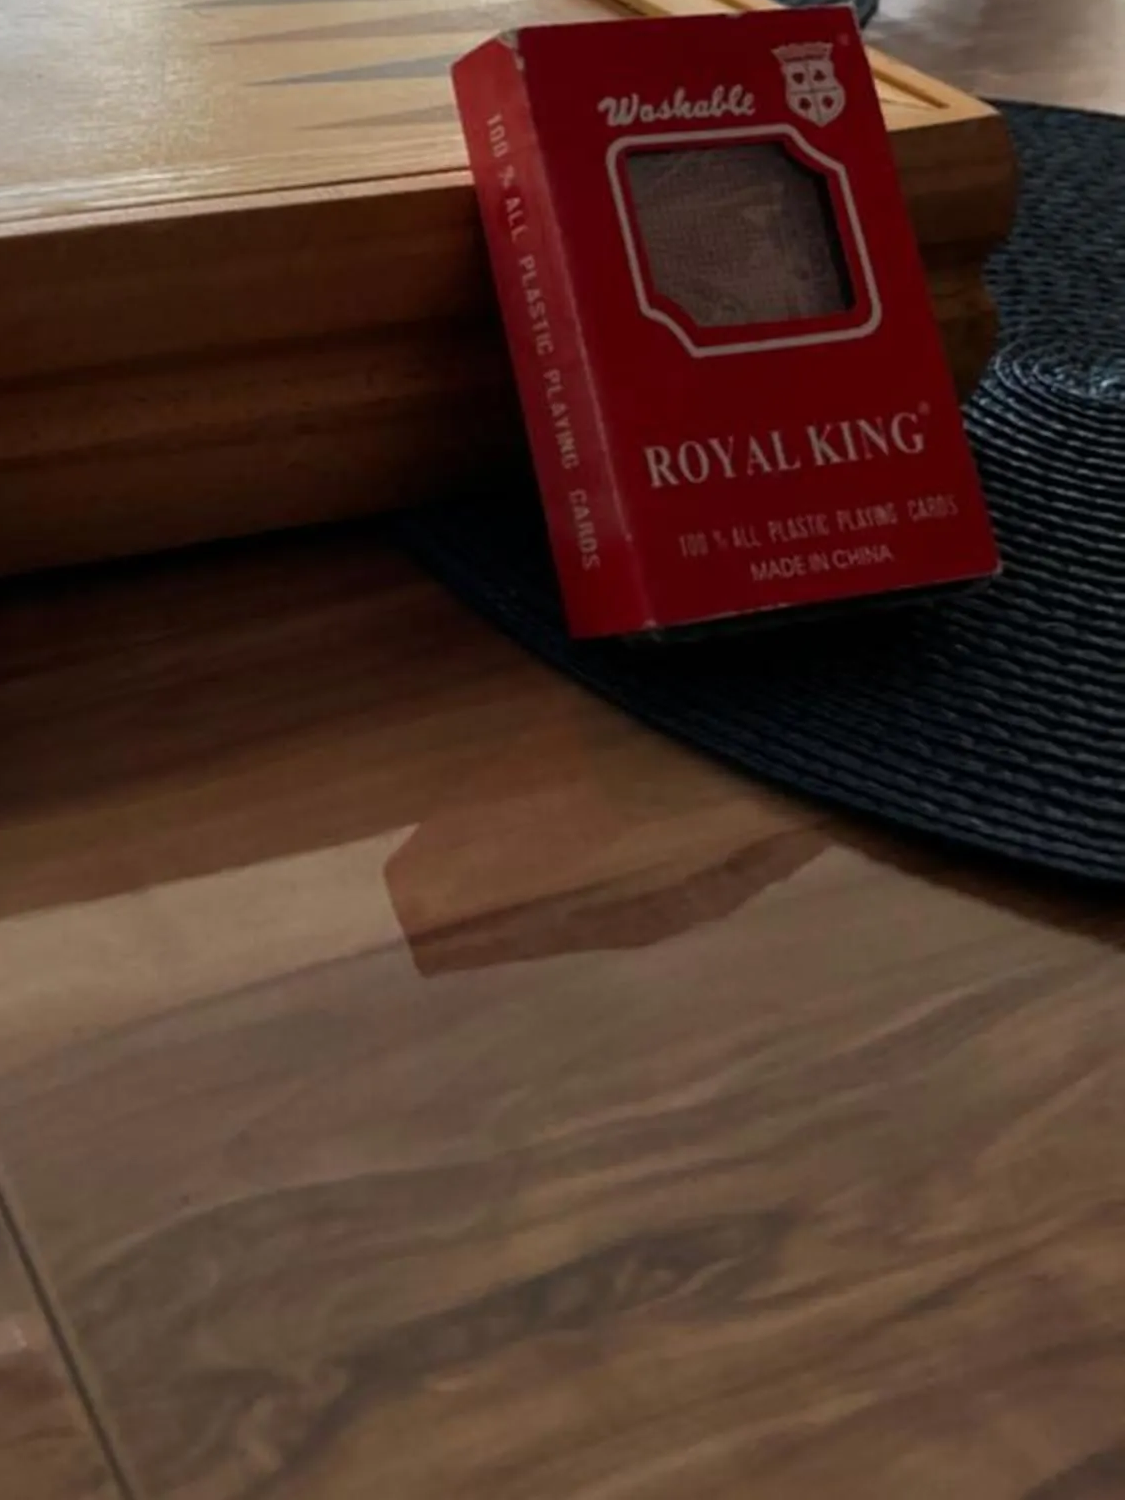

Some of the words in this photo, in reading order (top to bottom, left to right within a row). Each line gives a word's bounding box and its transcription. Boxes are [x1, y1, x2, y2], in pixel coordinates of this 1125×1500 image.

[598, 83, 757, 126] Washable
[485, 112, 510, 158] 100
[505, 195, 528, 245] ALL
[518, 254, 555, 357] PLASTIC
[543, 366, 580, 472] PLAYING
[567, 487, 602, 572] CARDS
[643, 429, 802, 490] ROYAL
[731, 525, 763, 549] ALL
[768, 512, 831, 544] PLASTIC
[835, 499, 898, 531] PLAYING
[906, 492, 960, 523] CARDS
[749, 553, 808, 583] MADE
[807, 551, 830, 574] IN
[832, 543, 894, 570] CHINA
